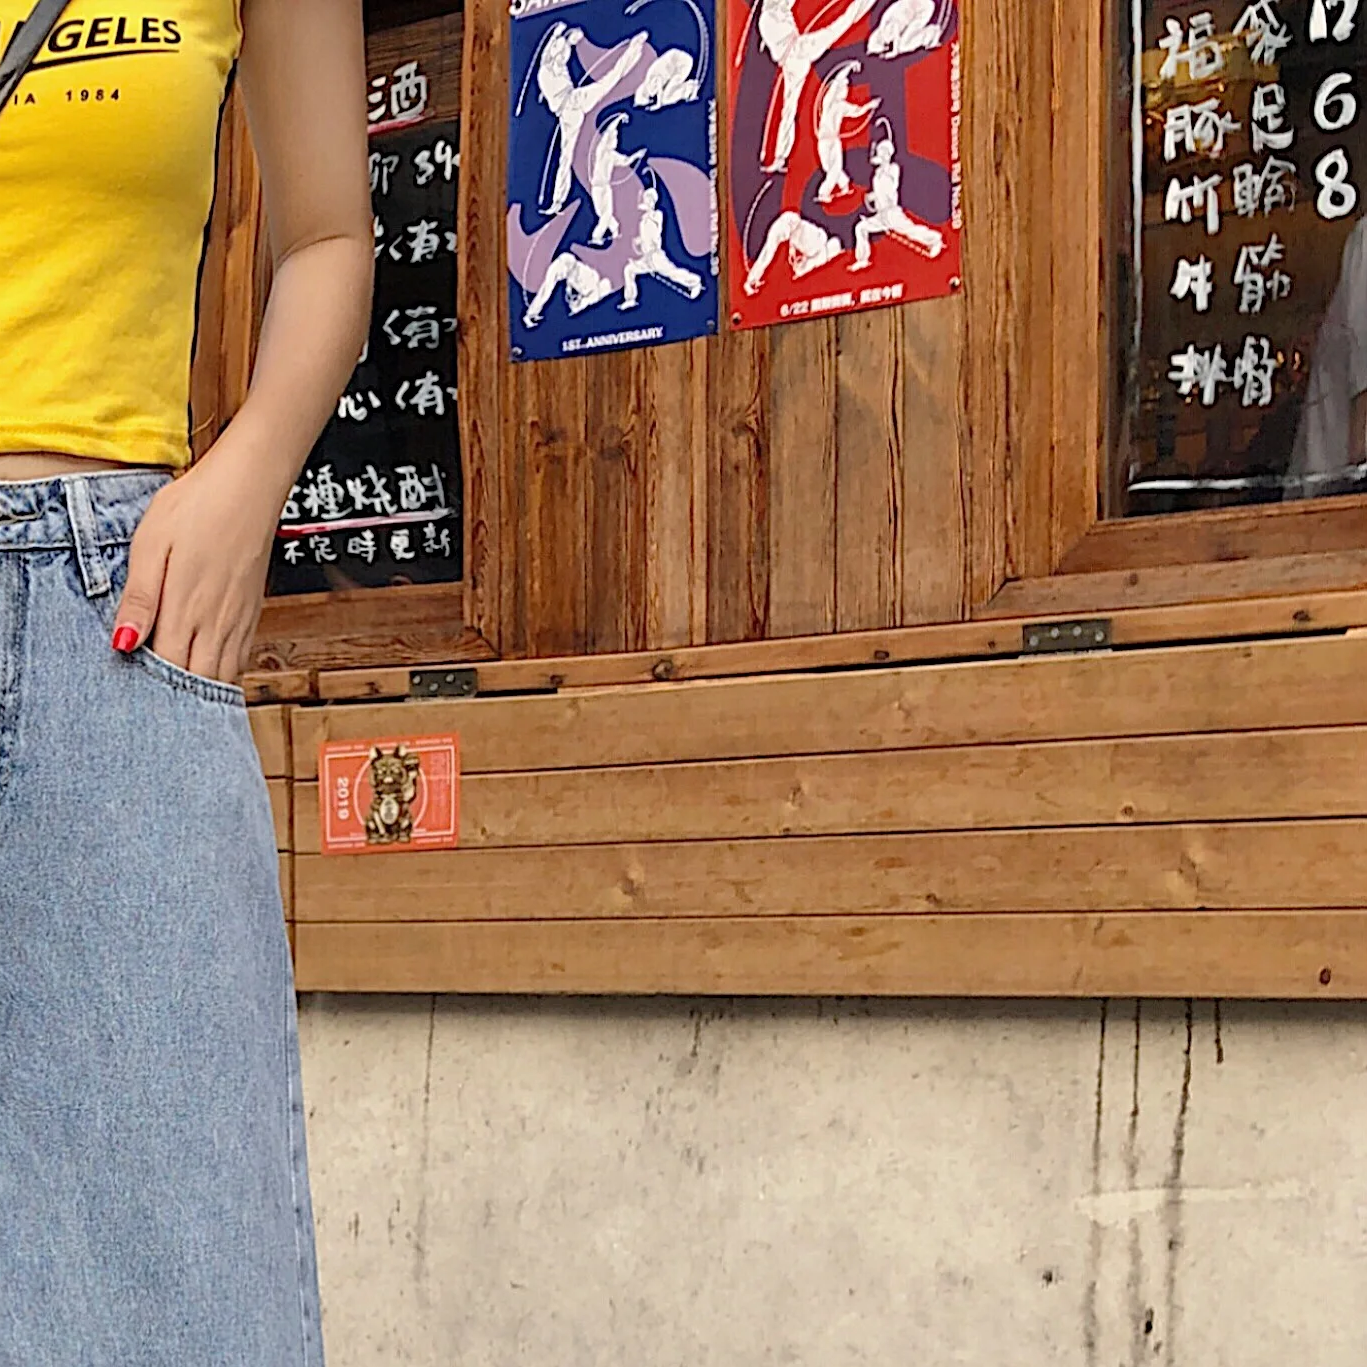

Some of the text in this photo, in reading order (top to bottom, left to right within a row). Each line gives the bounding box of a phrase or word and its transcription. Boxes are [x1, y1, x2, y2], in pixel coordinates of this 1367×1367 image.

[66, 88, 120, 102] 1984
[366, 60, 428, 121] 酒
[1314, 72, 1357, 131] 6
[1315, 148, 1357, 220] 8
